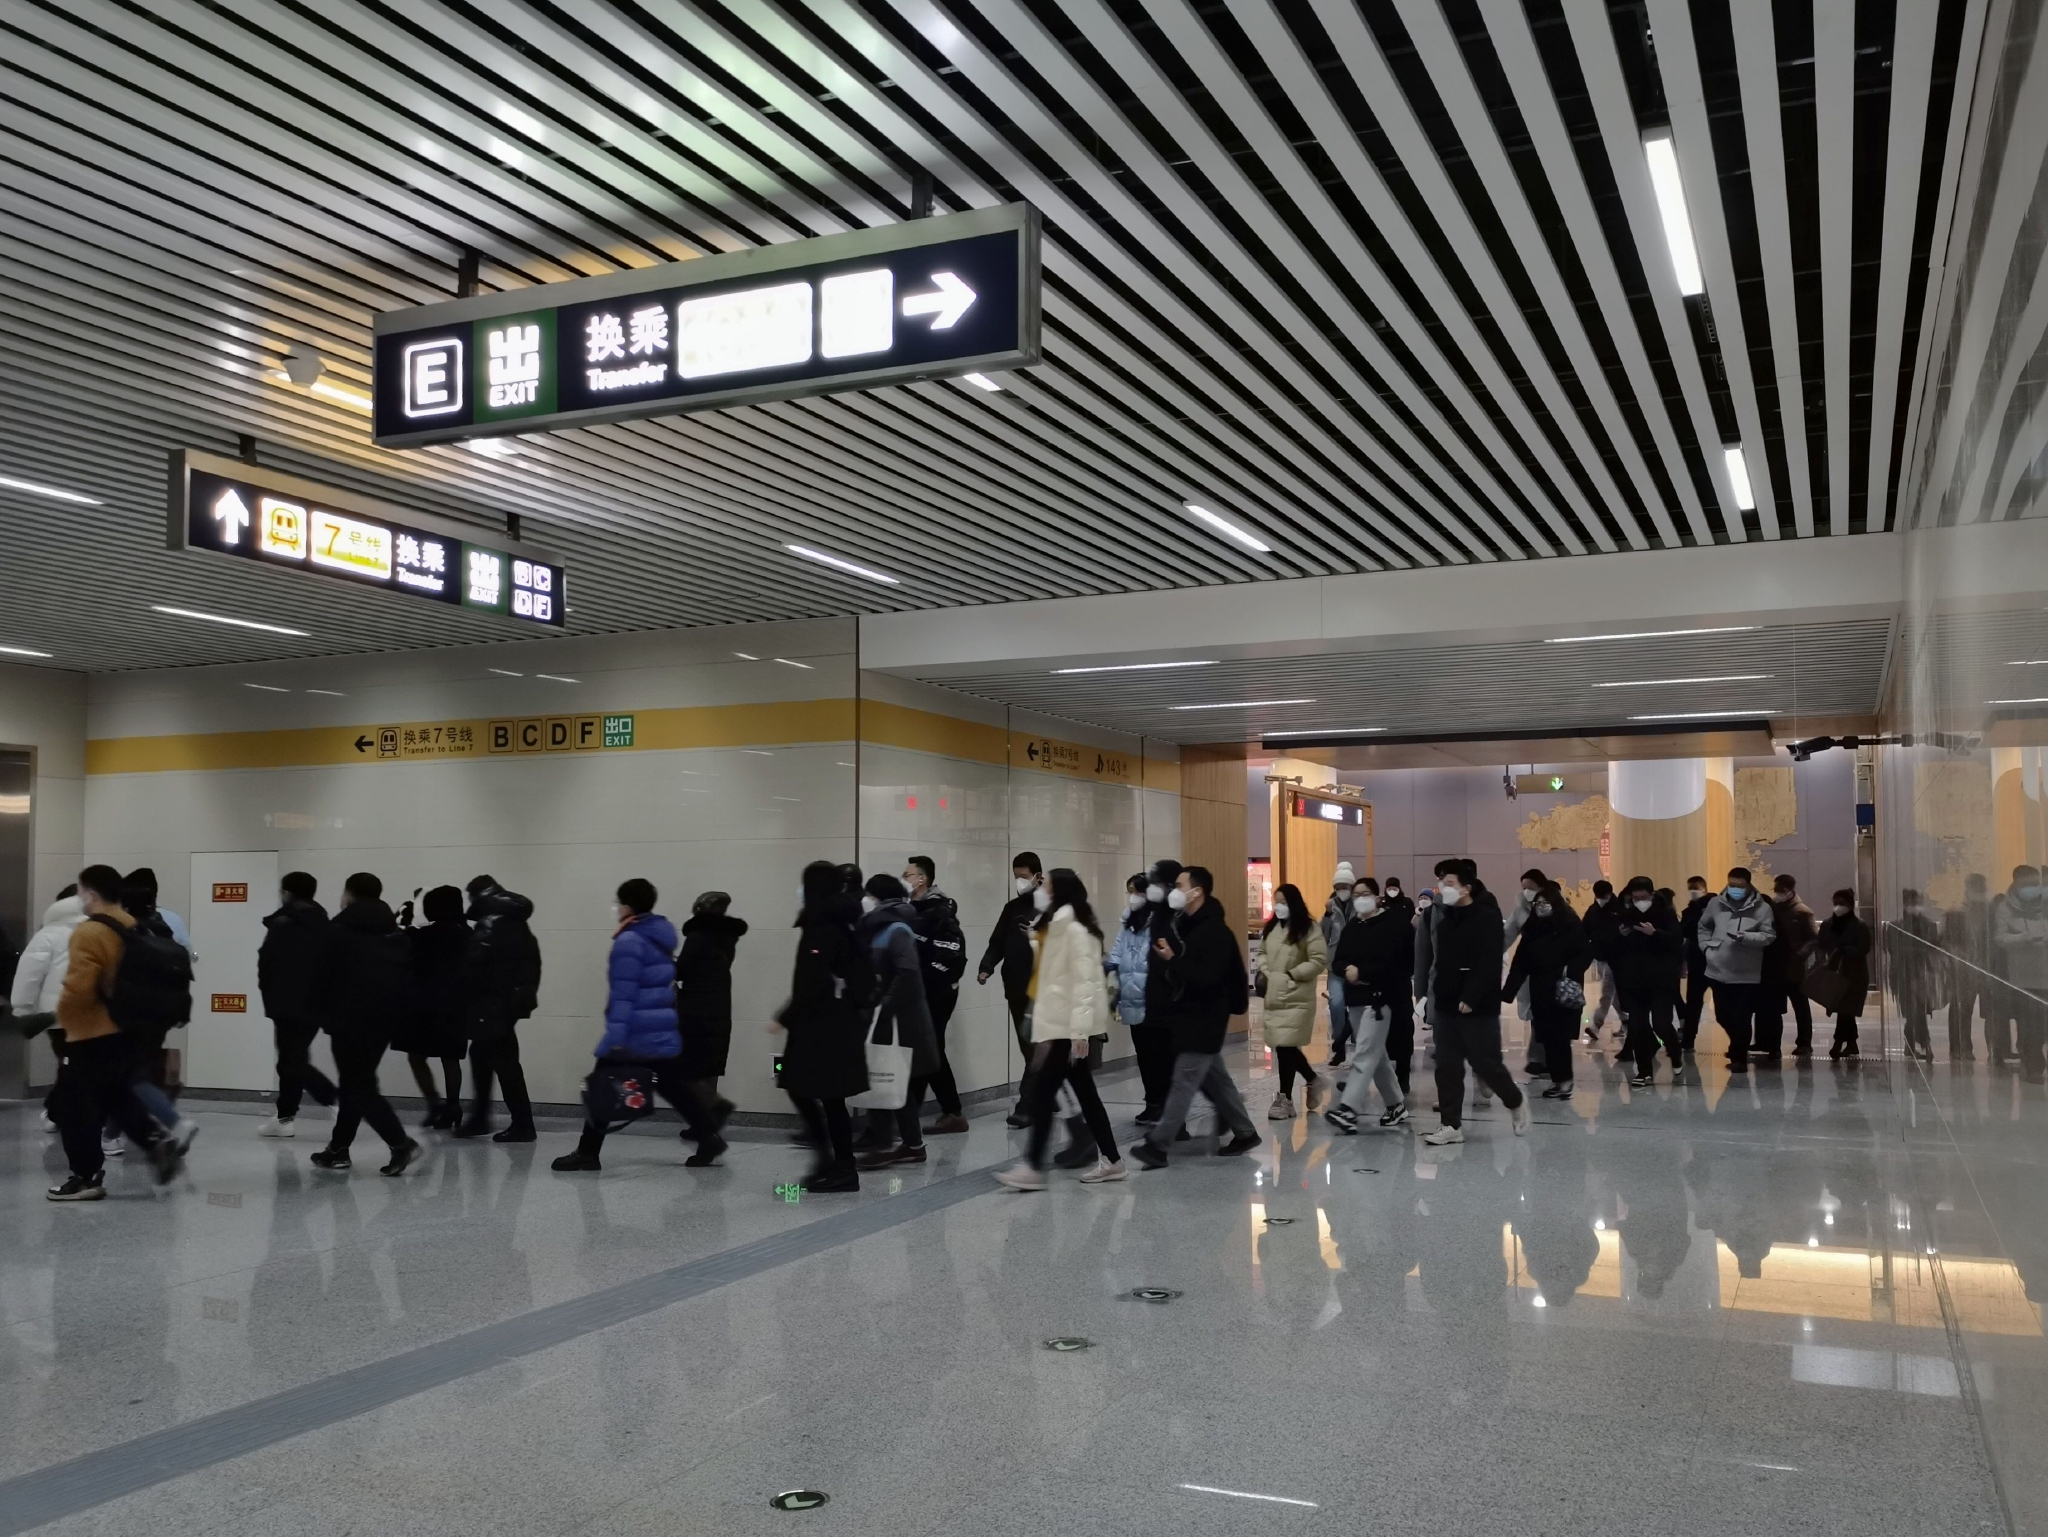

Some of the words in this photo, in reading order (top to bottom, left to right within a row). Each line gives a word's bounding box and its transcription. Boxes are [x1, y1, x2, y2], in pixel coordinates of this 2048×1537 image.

[586, 305, 668, 362] 换乘
[489, 325, 540, 385] 出
[416, 353, 449, 404] E
[586, 361, 668, 391] Transfer
[489, 380, 539, 407] EXIT
[396, 533, 445, 572] 换乘
[404, 727, 473, 745] 换乘7号线
[493, 726, 509, 748] B
[522, 724, 538, 747] C
[551, 723, 567, 746] D
[580, 721, 594, 744] F
[605, 717, 632, 734] 出口
[403, 746, 435, 754] Transfer
[438, 745, 446, 753] to
[449, 744, 466, 752] Line
[469, 743, 473, 751] 7
[605, 735, 631, 746] EXIT
